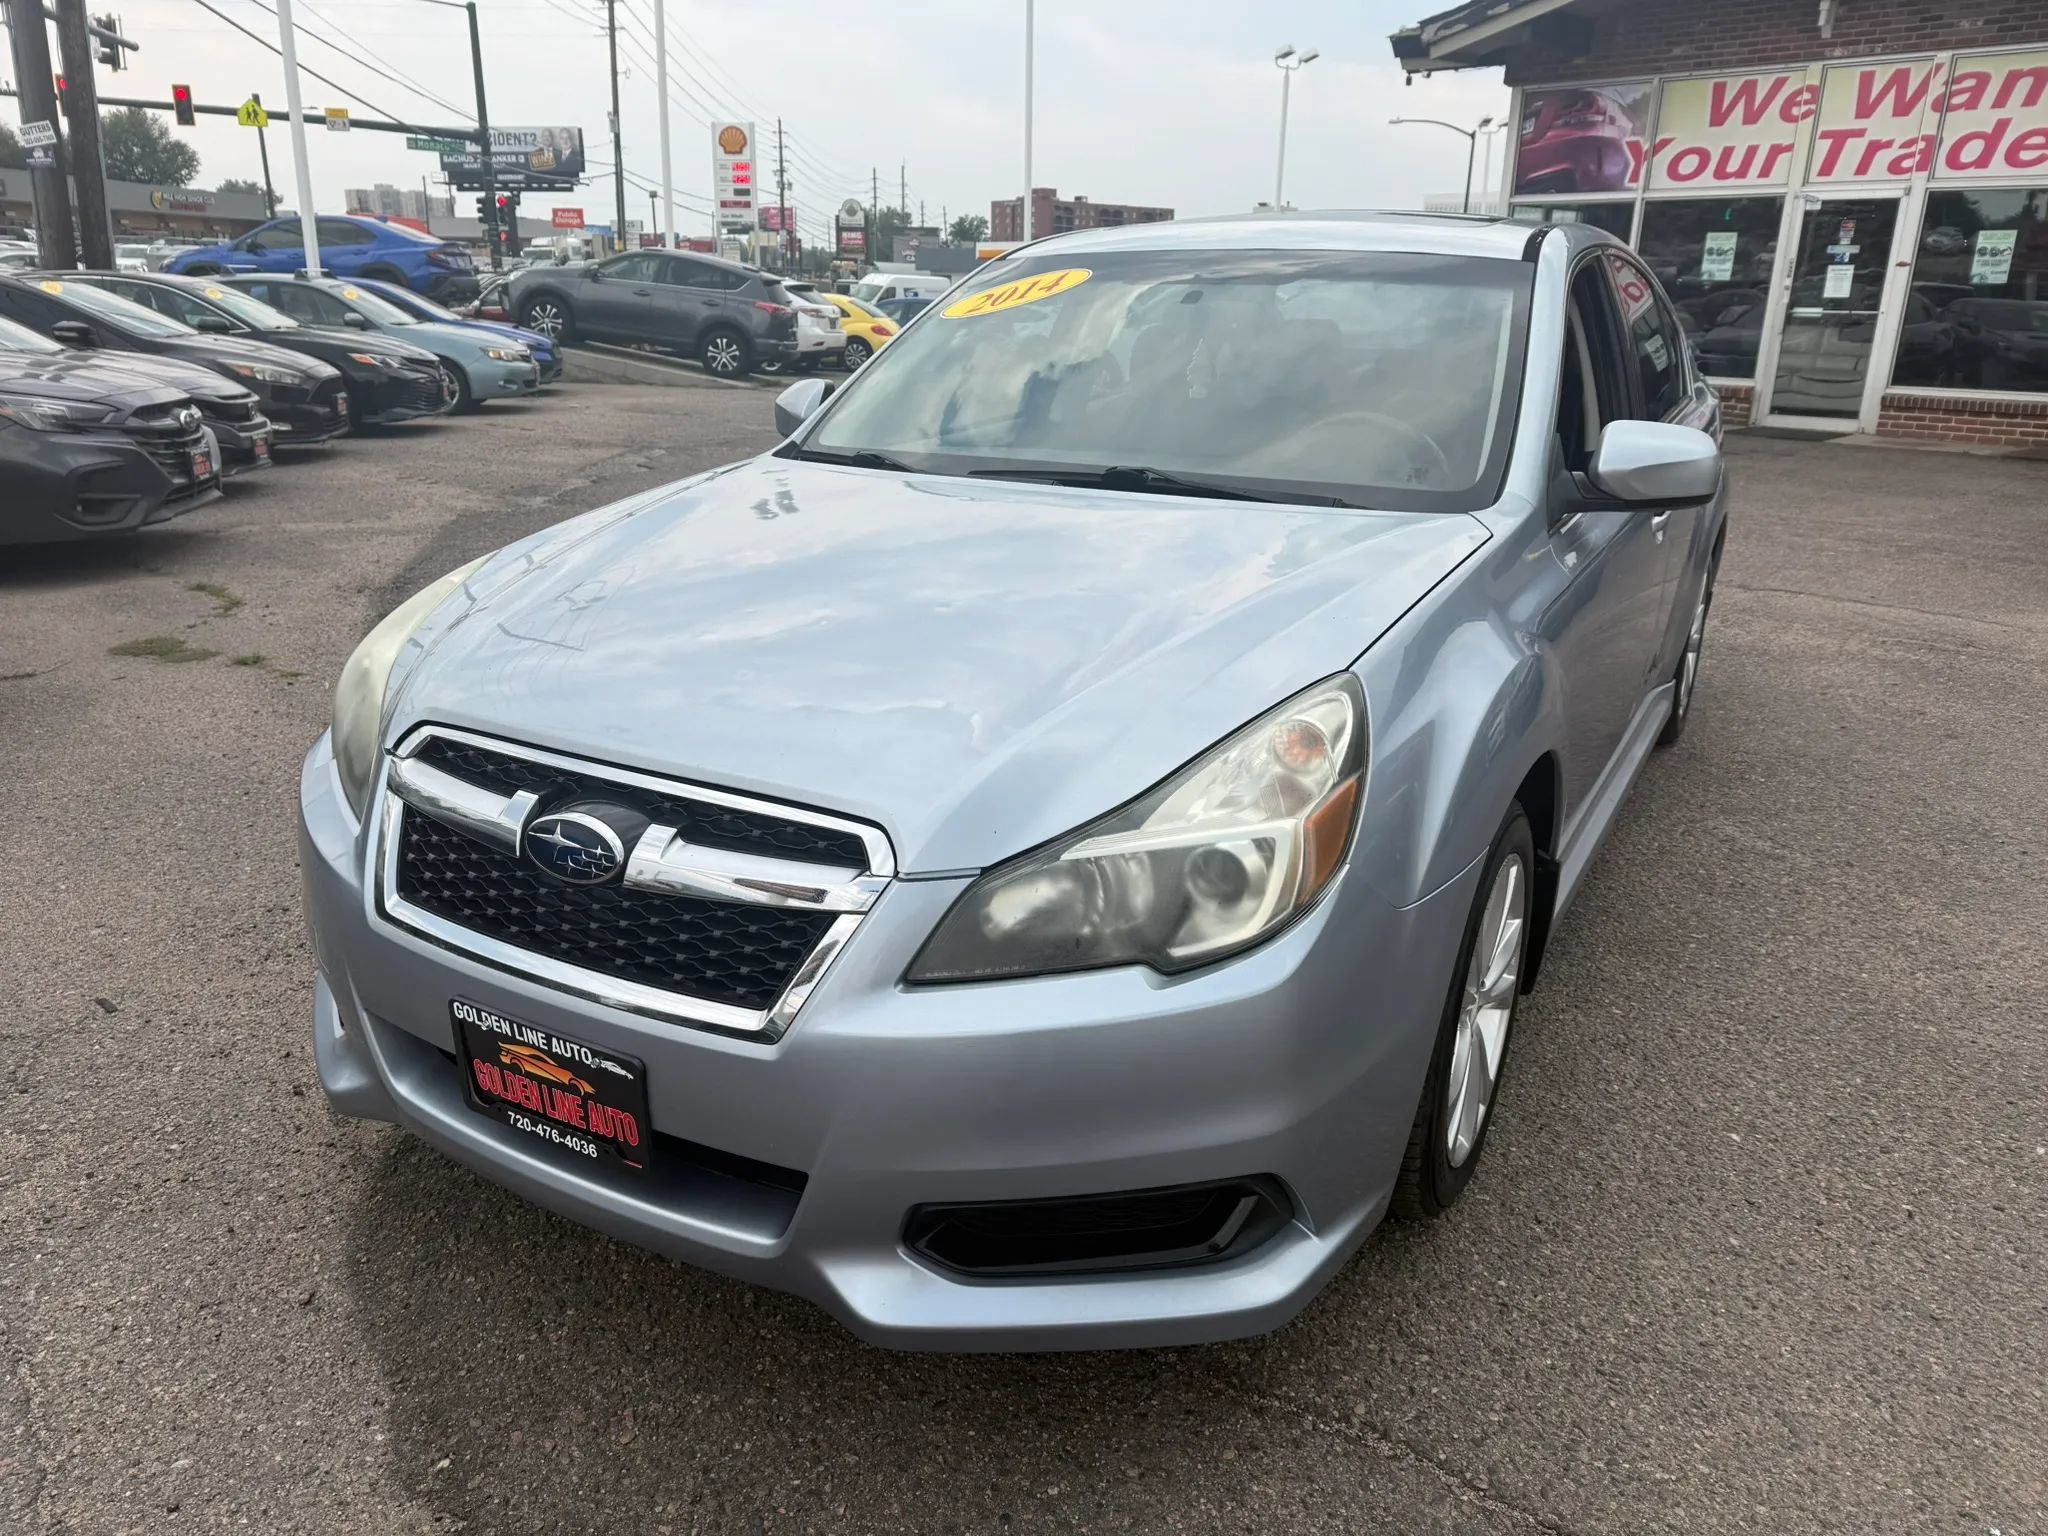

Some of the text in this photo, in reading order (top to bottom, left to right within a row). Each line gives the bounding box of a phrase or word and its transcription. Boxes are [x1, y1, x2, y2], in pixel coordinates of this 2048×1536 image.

[1708, 74, 1819, 128] We
[19, 123, 51, 137] GUTTERS
[1624, 117, 2048, 184] Your Trade
[963, 272, 1071, 315] 2014
[453, 1001, 592, 1065] GOLDEN LINE AUTO
[473, 1058, 640, 1147] GOLDEN LINE AUTO
[507, 1110, 599, 1158] 720-476-4036
